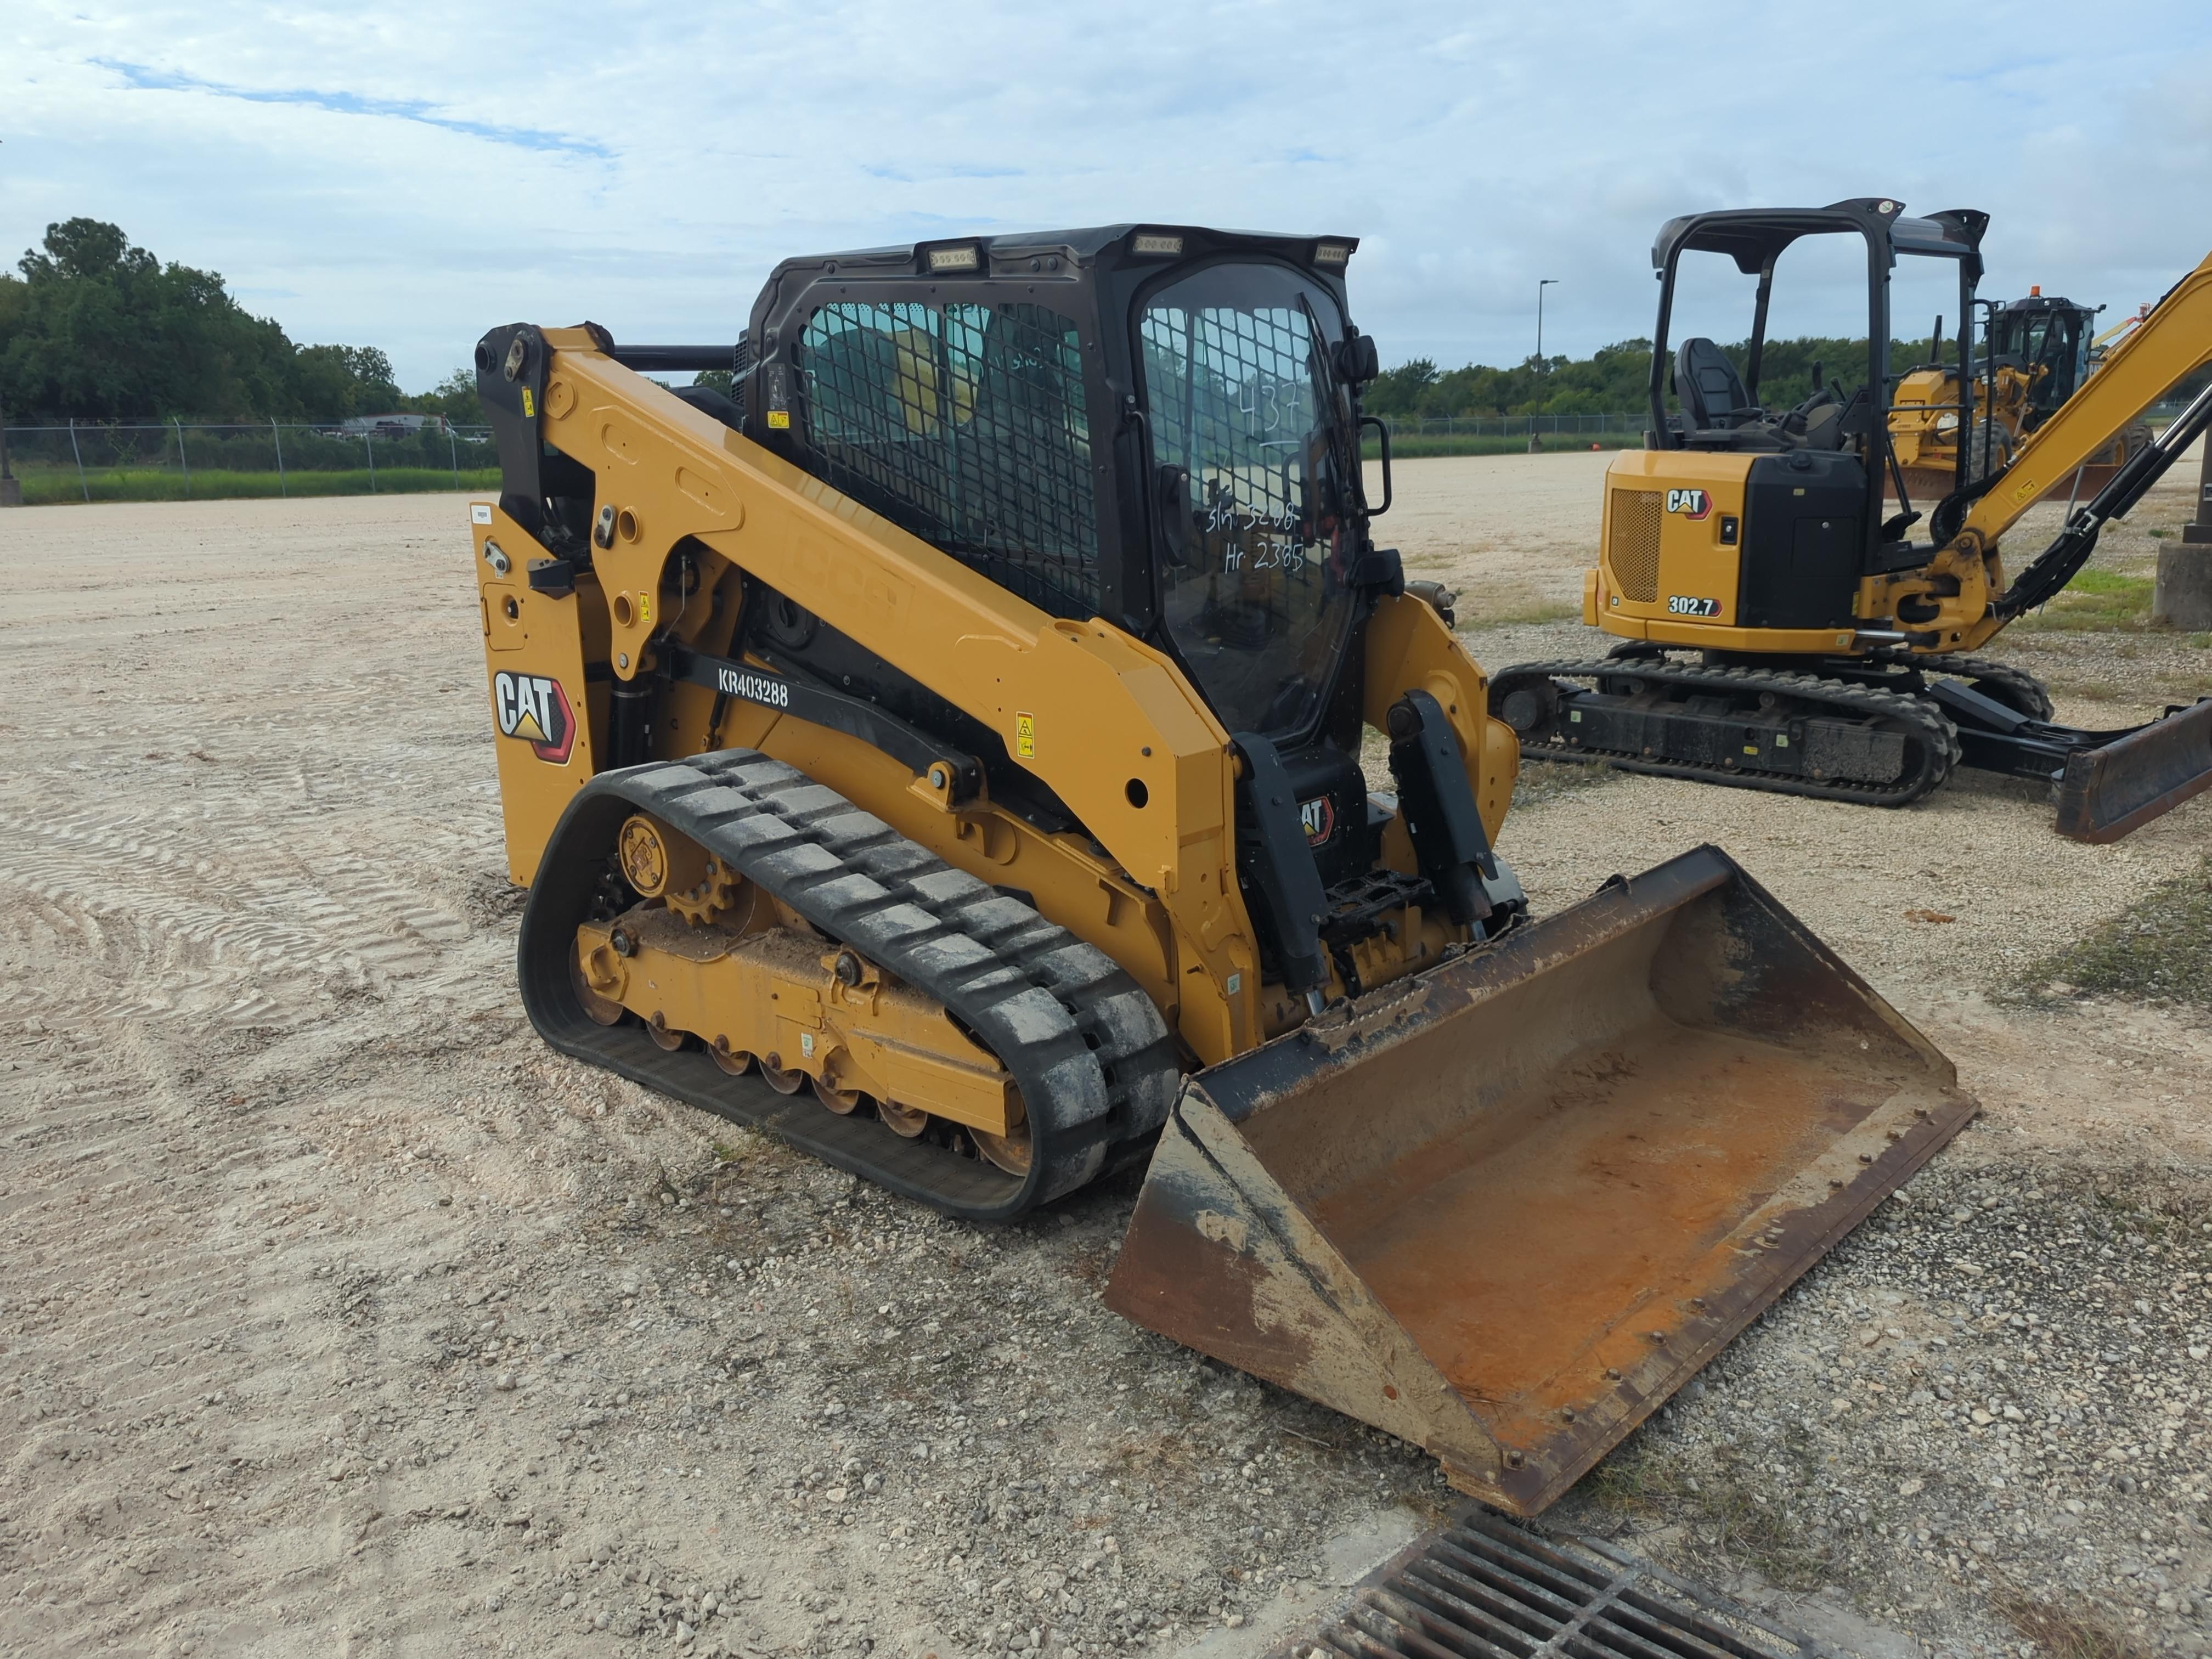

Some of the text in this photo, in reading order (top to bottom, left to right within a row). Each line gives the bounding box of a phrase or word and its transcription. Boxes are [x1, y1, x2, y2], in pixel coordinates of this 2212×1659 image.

[1239, 382, 1300, 437] 437
[1668, 489, 1702, 514] CAT
[1254, 541, 1304, 572] 2385
[1668, 596, 1714, 616] 302.7
[719, 668, 788, 707] KR403288
[495, 673, 552, 742] CAT
[1301, 799, 1322, 833] AT
